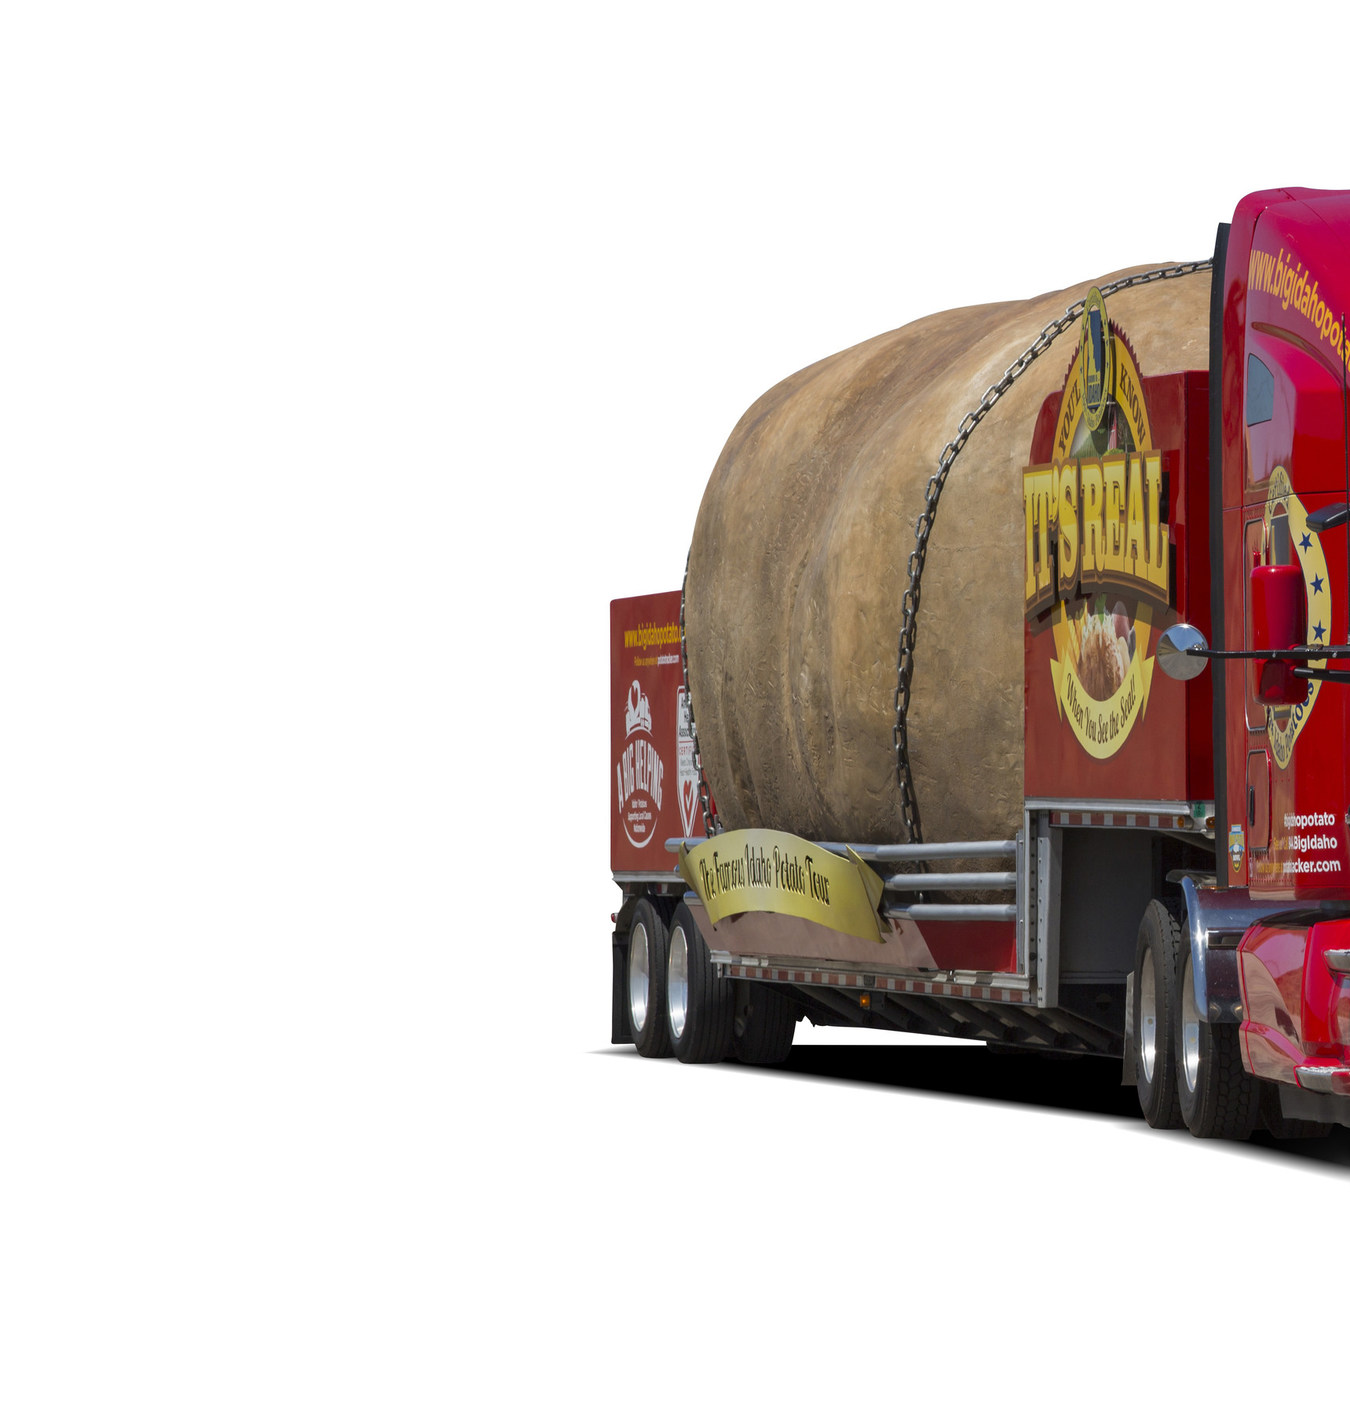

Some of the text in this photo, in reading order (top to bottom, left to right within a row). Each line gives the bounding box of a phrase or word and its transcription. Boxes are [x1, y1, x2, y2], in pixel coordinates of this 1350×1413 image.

[1059, 379, 1082, 457] YOU'L
[1120, 363, 1146, 446] KNOW
[1024, 456, 1169, 600] IT'S REAL
[1067, 672, 1084, 730] When
[1085, 706, 1096, 742] You
[1097, 713, 1108, 744] See
[1110, 710, 1119, 740] the
[617, 739, 664, 814] A BIG HELPING
[699, 843, 831, 907] The Famous Idaho Potato Tour
